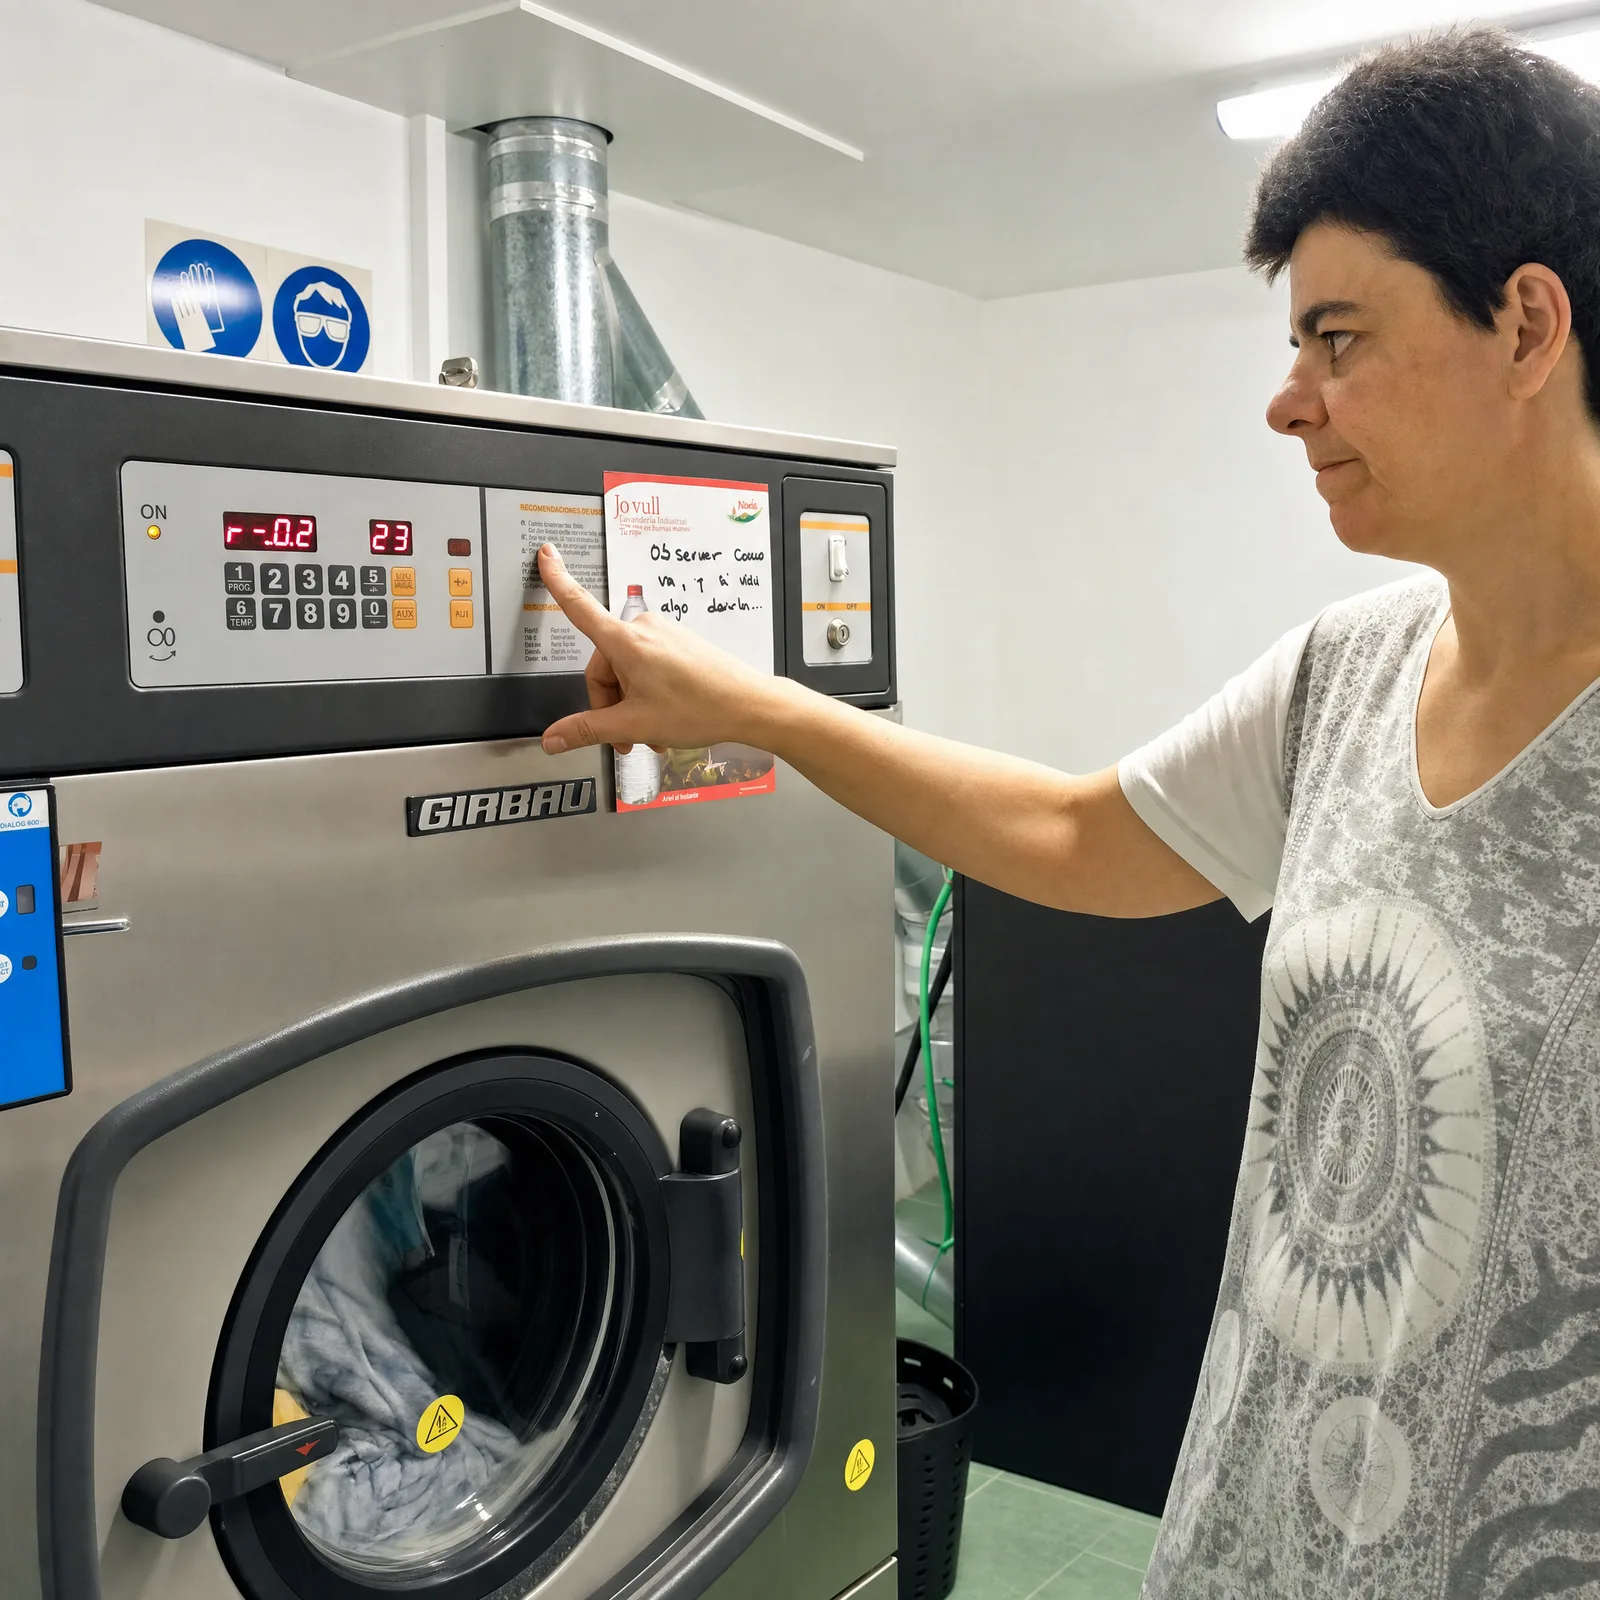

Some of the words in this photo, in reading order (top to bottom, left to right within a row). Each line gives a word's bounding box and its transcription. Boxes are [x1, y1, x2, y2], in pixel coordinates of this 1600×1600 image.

[140, 504, 167, 520] ON
[520, 503, 581, 515] RECOMENDACIONES
[632, 496, 660, 515] vull
[372, 523, 409, 551] 23
[235, 565, 243, 580] 1
[268, 568, 282, 589] 2
[302, 569, 316, 590] 3
[335, 570, 349, 590] 4
[369, 569, 378, 583] 5
[228, 583, 252, 592] PROG.
[236, 601, 246, 615] 6
[269, 603, 283, 624] 7
[304, 603, 318, 624] 8
[336, 603, 350, 623] 9
[370, 601, 379, 615] 0
[395, 609, 414, 618] AUX
[660, 598, 689, 621] algo
[230, 618, 254, 627] TEMP.
[418, 781, 592, 831] GIRBAU
